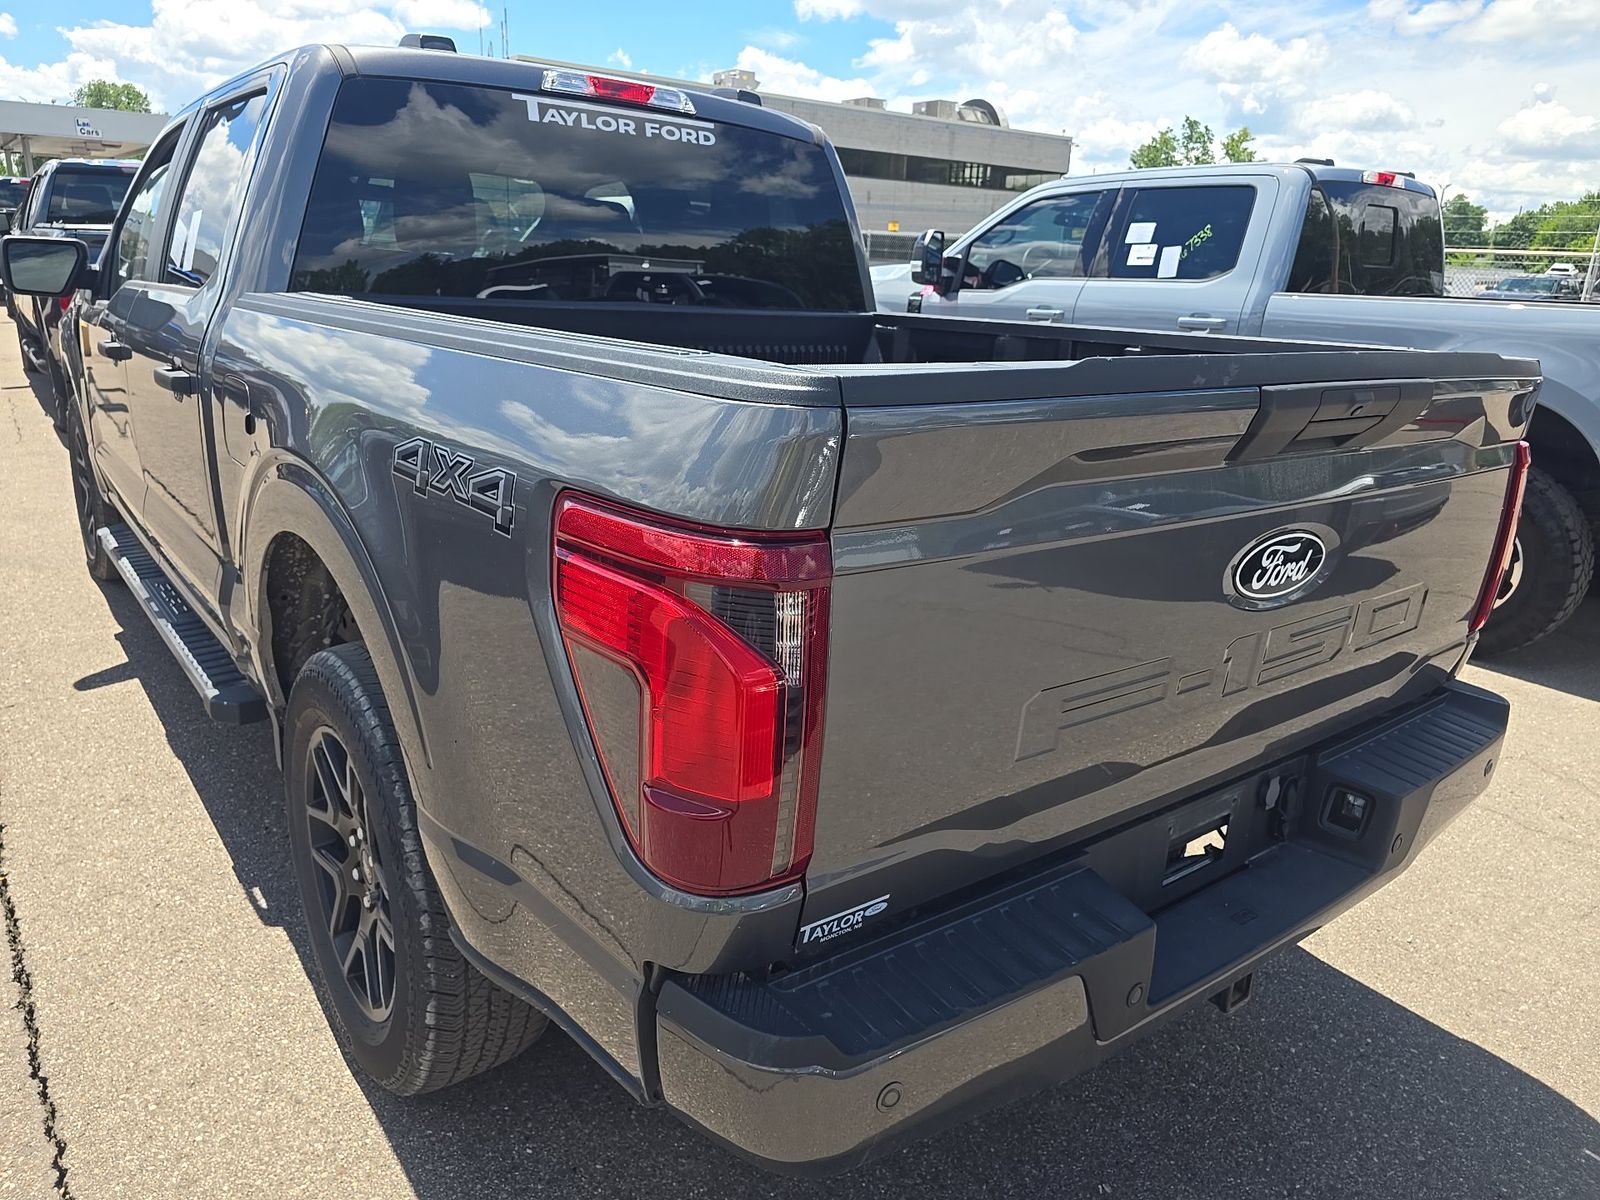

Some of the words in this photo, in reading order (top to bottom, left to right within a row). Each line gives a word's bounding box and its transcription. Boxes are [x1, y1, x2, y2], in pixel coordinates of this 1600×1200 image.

[79, 127, 100, 136] Cars
[511, 92, 637, 136] TAYLOR
[644, 121, 716, 146] FORD
[1250, 543, 1314, 589] Ford
[1015, 582, 1429, 762] F-150
[800, 909, 865, 944] TAYLOR
